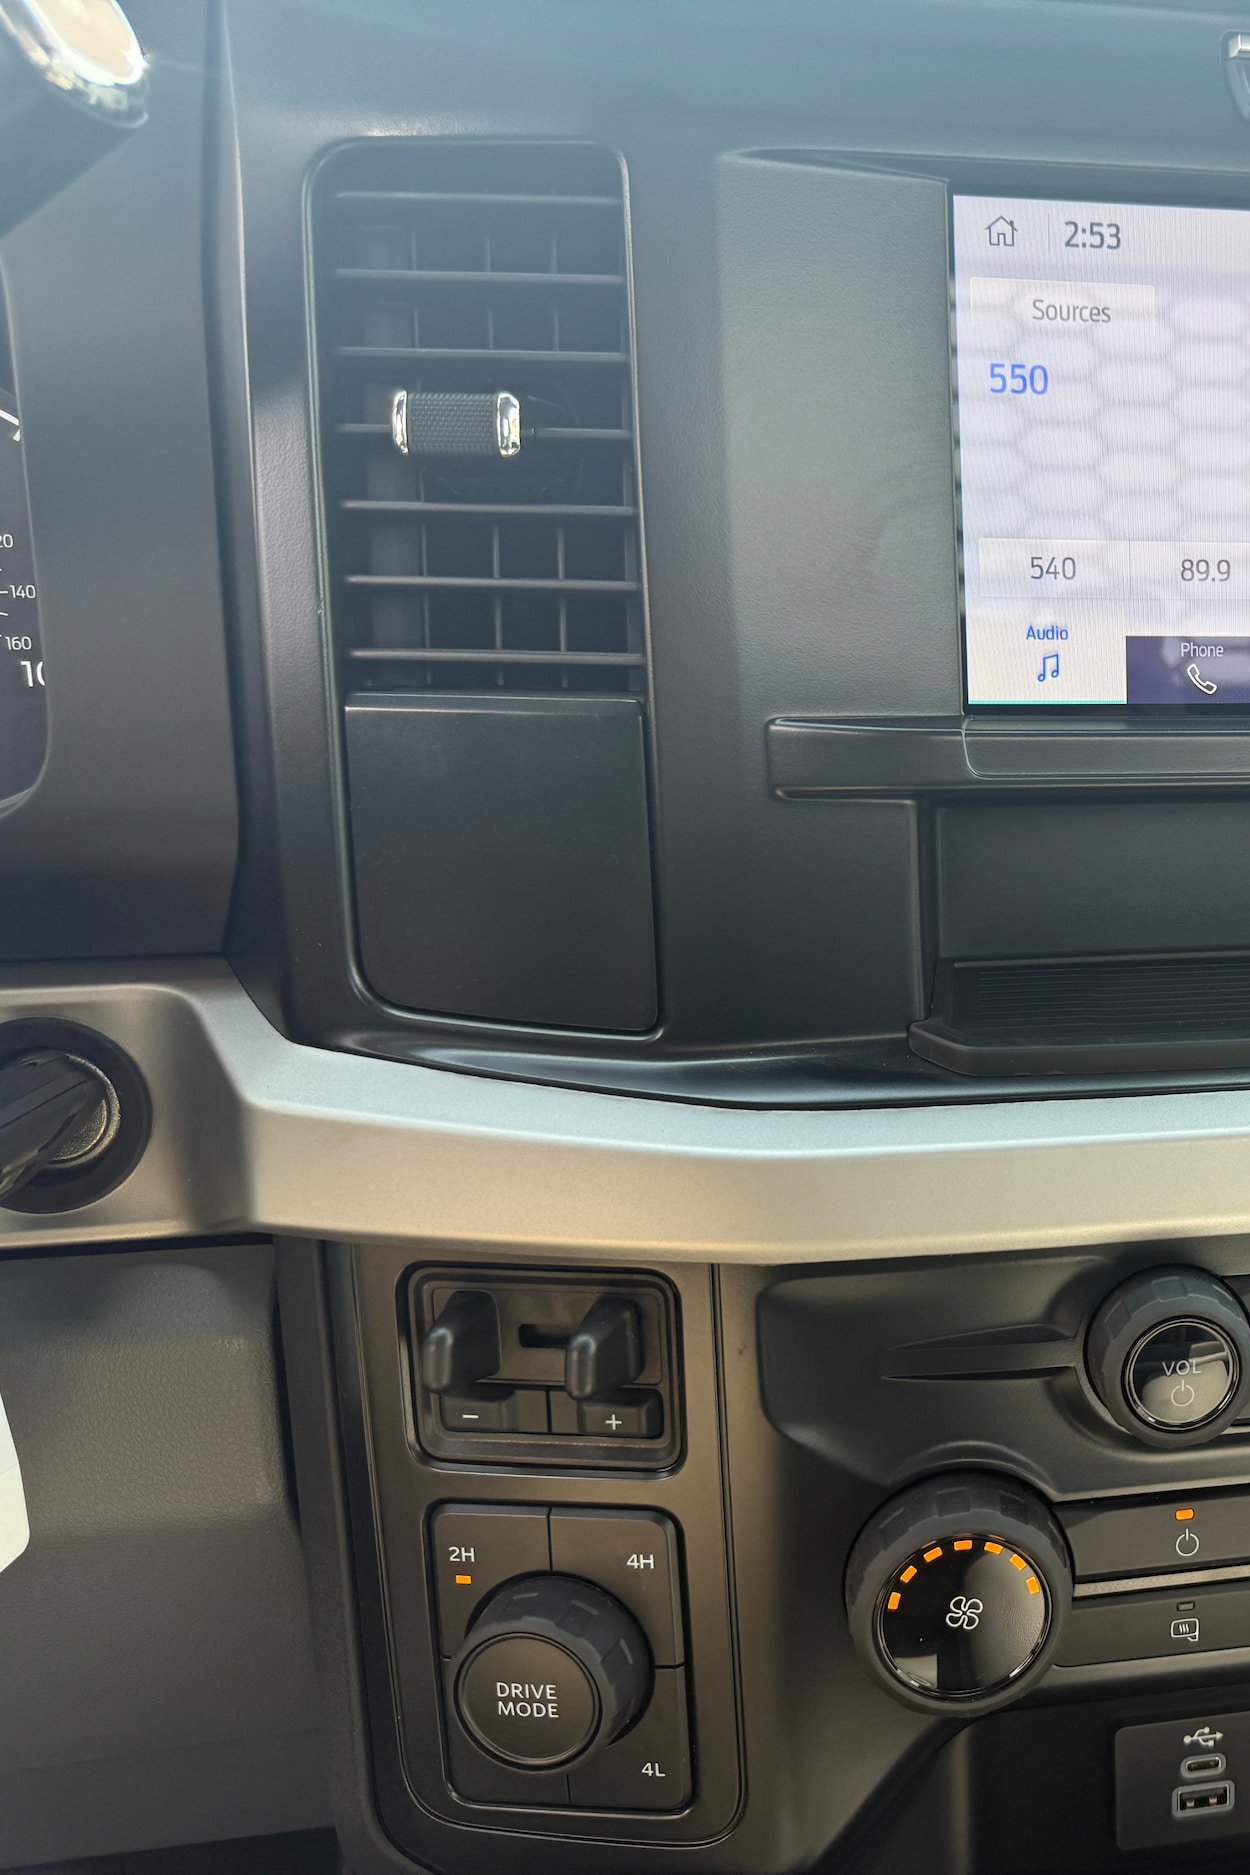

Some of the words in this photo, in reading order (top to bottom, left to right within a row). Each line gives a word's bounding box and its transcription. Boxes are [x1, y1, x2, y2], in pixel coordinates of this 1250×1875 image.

[1063, 221, 1121, 249] 2:53
[1031, 299, 1111, 326] Sources
[988, 363, 1049, 395] 550
[1029, 557, 1077, 580] 540
[1180, 559, 1231, 583] 89.9
[10, 584, 36, 599] 140
[1026, 625, 1069, 642] Audio
[5, 636, 32, 651] 160
[1180, 642, 1225, 659] Phone
[1162, 1359, 1202, 1376] VOL
[448, 1546, 476, 1563] 2H
[626, 1554, 655, 1570] 4H
[496, 1682, 557, 1701] DRIVE
[497, 1700, 559, 1719] MODE
[641, 1763, 666, 1778] 4L
